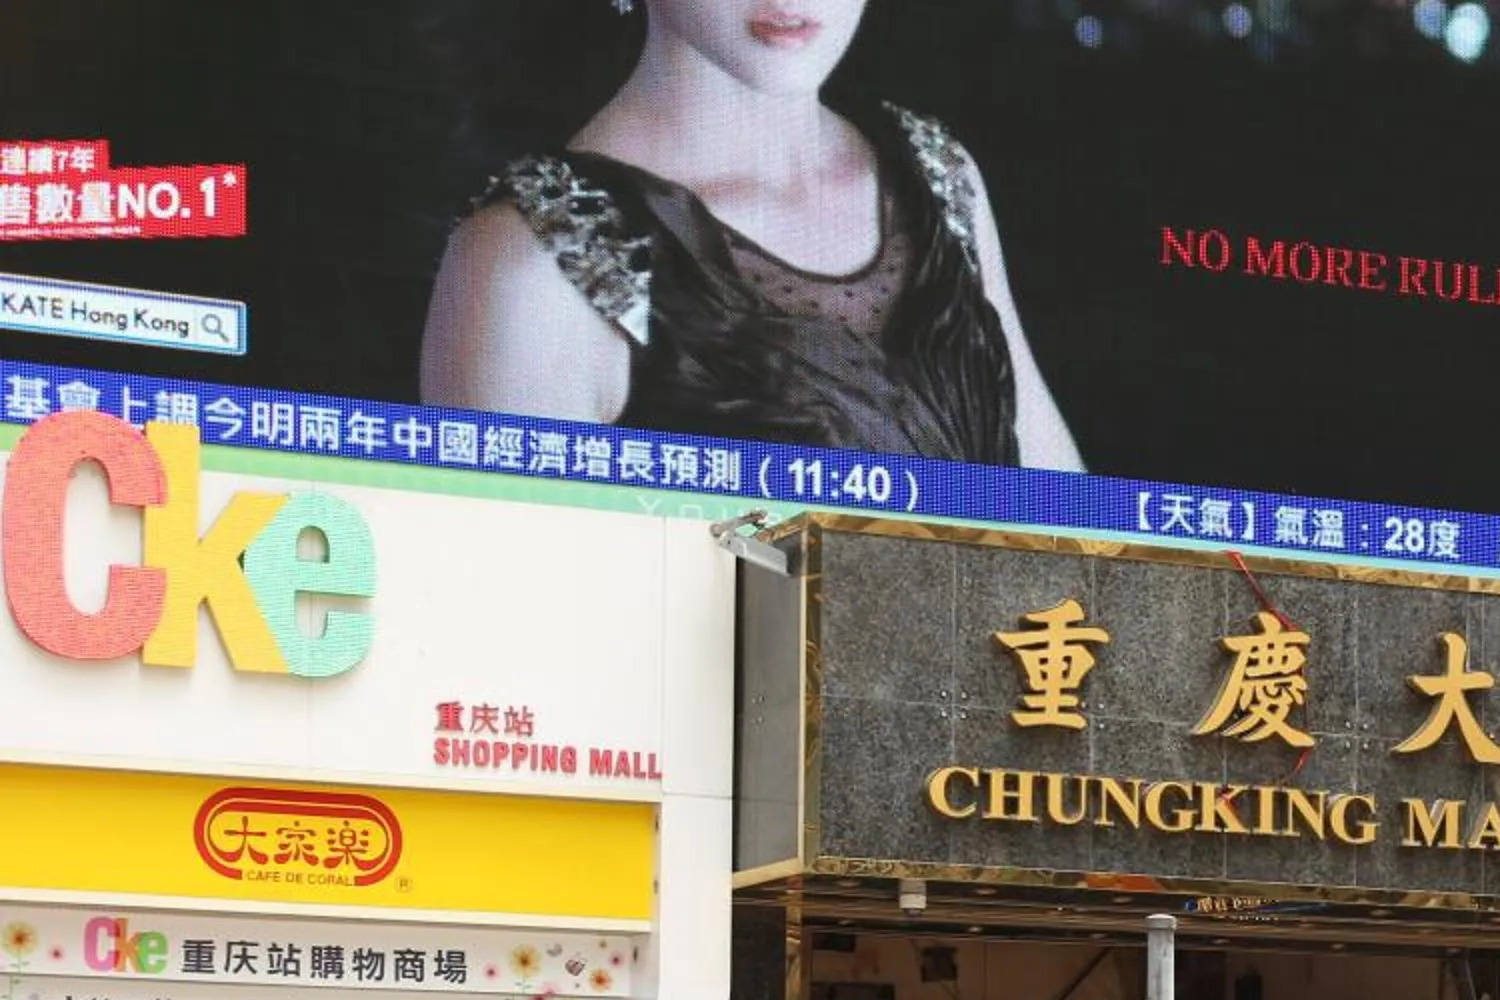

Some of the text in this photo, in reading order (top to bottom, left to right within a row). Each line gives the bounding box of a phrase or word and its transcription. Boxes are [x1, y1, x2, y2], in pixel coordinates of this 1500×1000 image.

[1159, 227, 1230, 272] NO
[1244, 236, 1388, 291] MORE
[1, 291, 190, 338] KATE Hong Kong
[2, 408, 377, 678] Cke
[432, 700, 535, 738] 重庆站
[432, 737, 663, 780] SHOPPING MALL
[926, 765, 1380, 848] CHUNGKING
[246, 870, 354, 887] CAFE DE CORAL
[83, 915, 469, 985] Cke 重庆站購物商場
